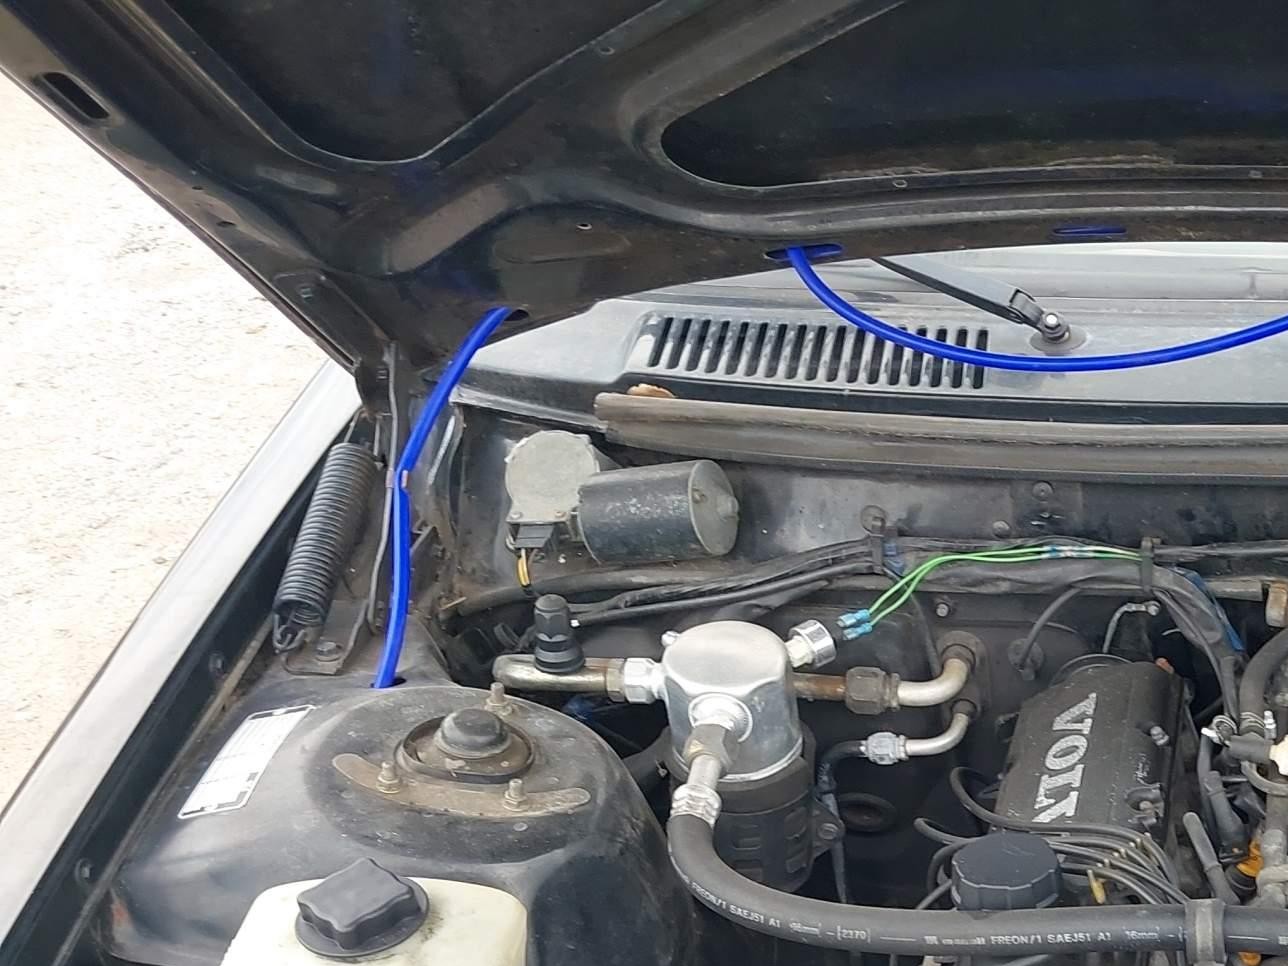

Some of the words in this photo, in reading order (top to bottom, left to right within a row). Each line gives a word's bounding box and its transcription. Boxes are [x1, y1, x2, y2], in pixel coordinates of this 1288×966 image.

[1031, 691, 1098, 823] VOLV
[729, 904, 765, 925] SAEJ51
[990, 934, 1043, 946] FREON/1
[1046, 932, 1093, 945] SAEJ51
[1097, 931, 1113, 942] A1
